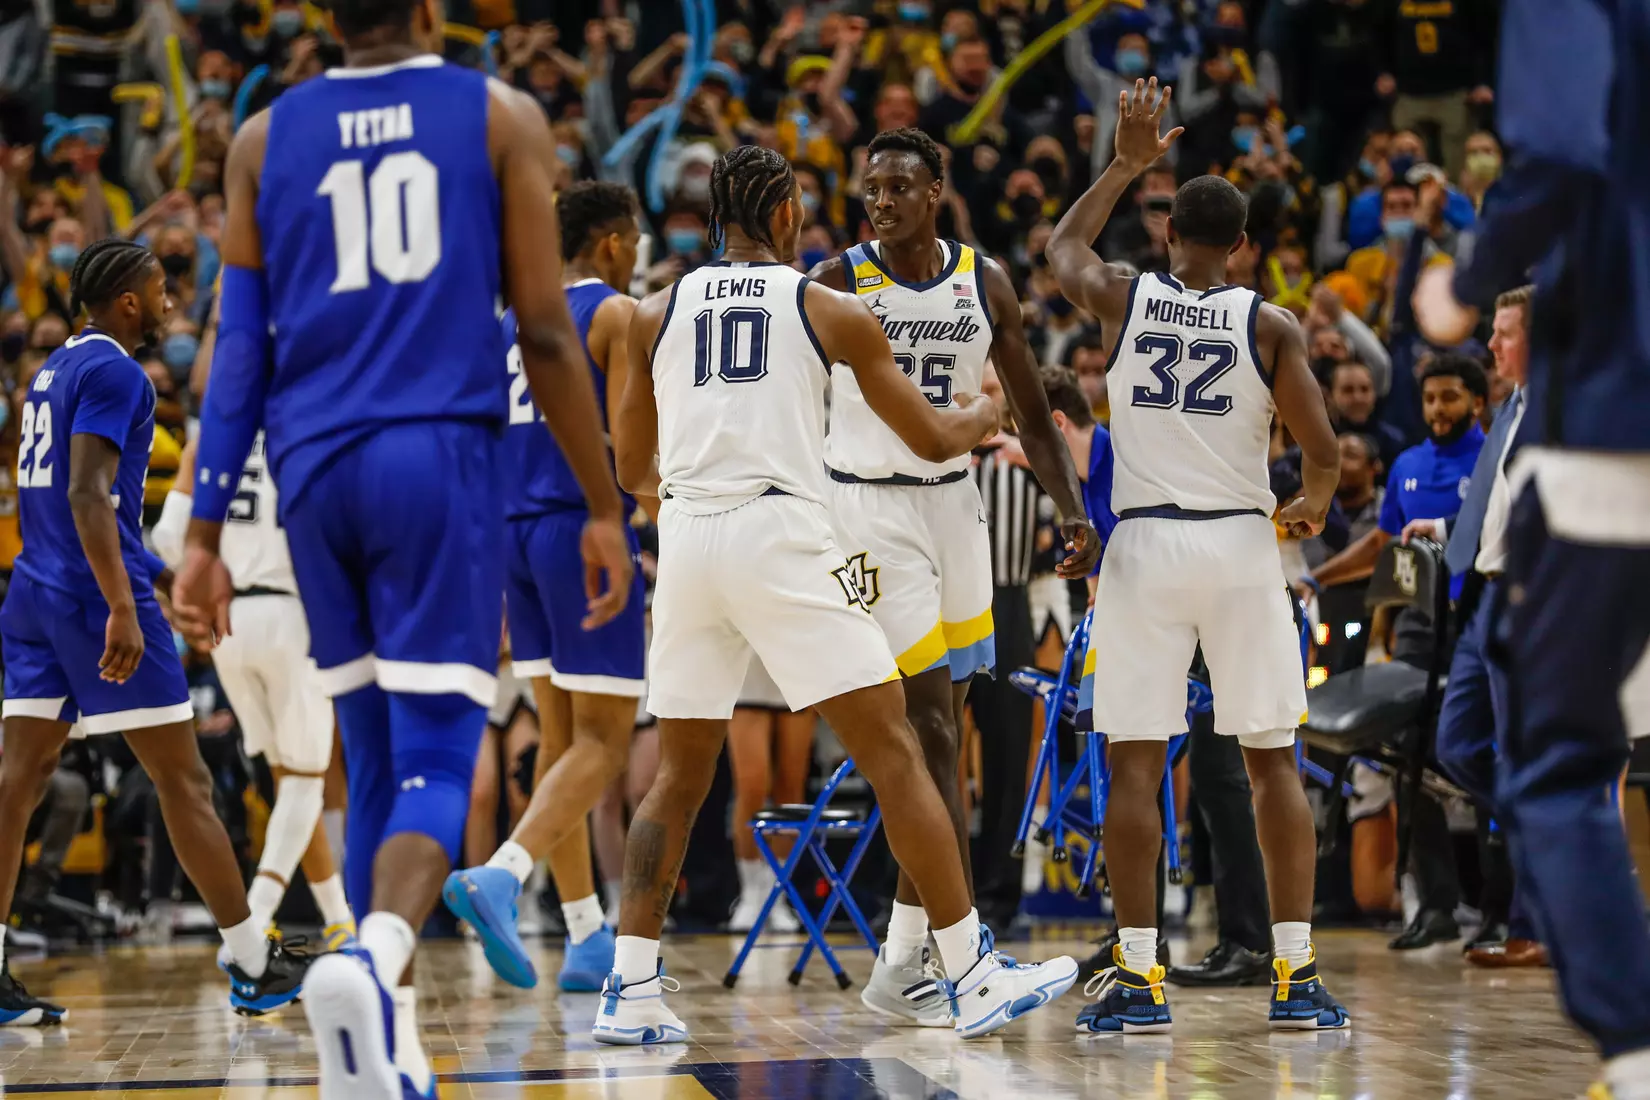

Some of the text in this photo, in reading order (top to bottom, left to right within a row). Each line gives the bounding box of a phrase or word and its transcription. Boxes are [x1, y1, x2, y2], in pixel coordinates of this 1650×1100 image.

[315, 150, 442, 294] 10
[705, 278, 766, 301] LEWIS
[1144, 298, 1233, 331] MORSELL
[506, 343, 547, 425] 2
[693, 306, 772, 387] 10
[1130, 331, 1238, 416] 32
[17, 401, 54, 488] 22
